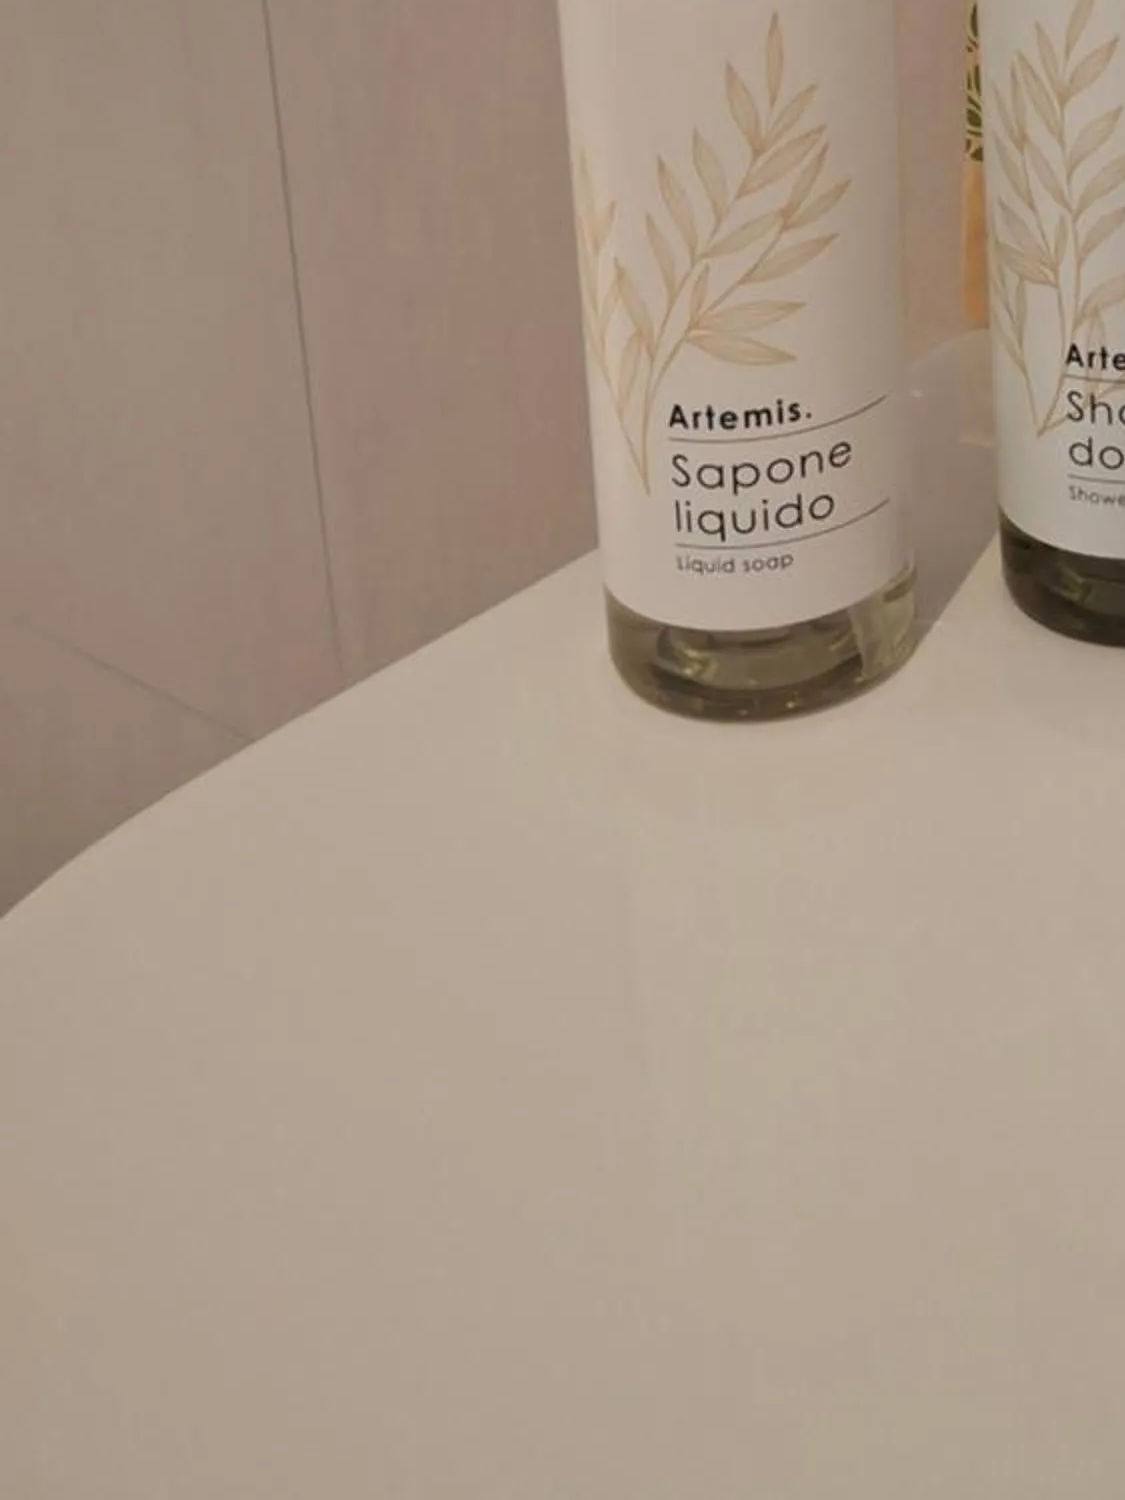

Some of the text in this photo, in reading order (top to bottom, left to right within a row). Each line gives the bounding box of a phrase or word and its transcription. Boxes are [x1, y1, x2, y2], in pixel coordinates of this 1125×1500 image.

[668, 398, 813, 431] Artemis.
[671, 441, 852, 496] Sapone
[674, 493, 835, 543] liquido
[675, 553, 795, 576] Liquid soap
